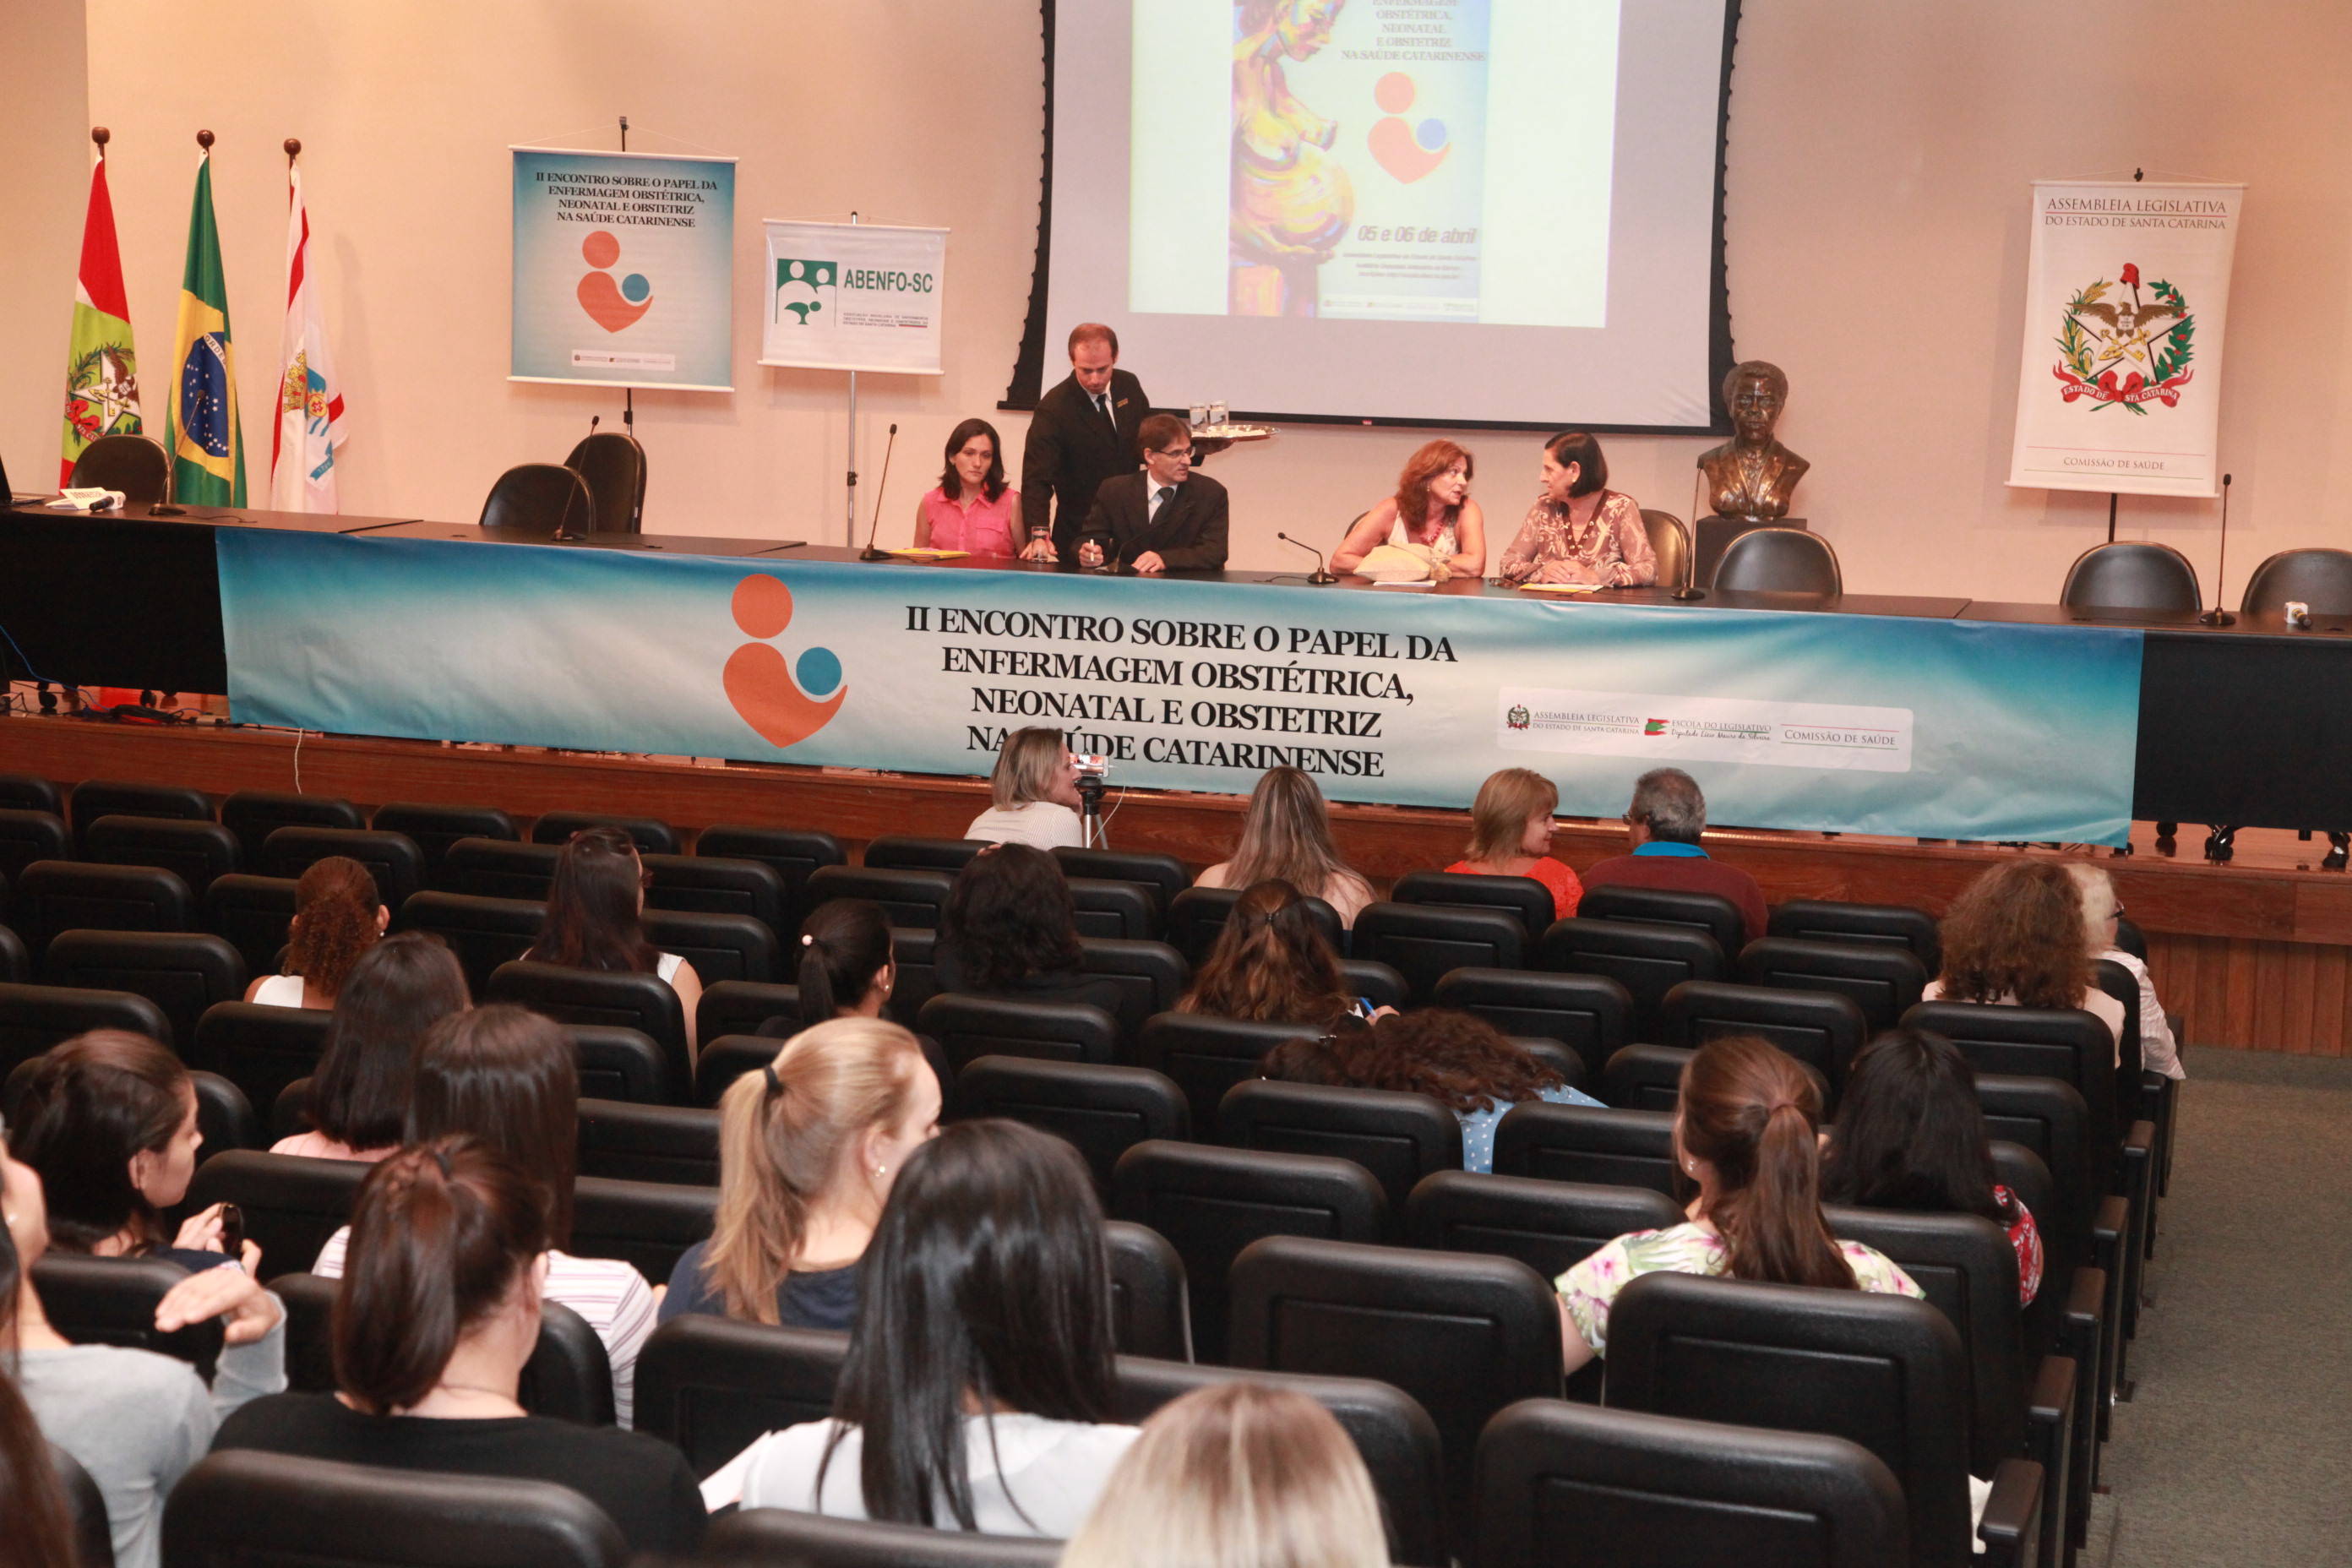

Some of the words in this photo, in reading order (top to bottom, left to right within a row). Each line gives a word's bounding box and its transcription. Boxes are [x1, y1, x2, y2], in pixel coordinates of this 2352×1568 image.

[1381, 24, 1446, 34] NEONATAL
[1376, 37, 1385, 46] E
[1386, 37, 1451, 47] OBSTETRIZ
[1341, 50, 1358, 59] NA
[1360, 47, 1401, 60] SAÚDE
[1402, 51, 1486, 62] CATARINENSE
[536, 172, 544, 182] II
[547, 172, 610, 185] ENCONTRO
[612, 176, 651, 187] SOBRE
[652, 178, 662, 188] O
[664, 179, 700, 189] PAPEL
[701, 181, 717, 190] DA
[548, 186, 629, 199] ENFERMAGEM
[632, 189, 705, 204] OBSTÉTRICA,
[558, 199, 621, 211] NEONATAL
[623, 203, 630, 211] E
[632, 203, 695, 215] OBSTETRIZ
[2047, 198, 2132, 211] ASSEMBLEIA
[2137, 199, 2227, 213] LEGISLATIVA
[558, 211, 574, 221] NA
[576, 211, 615, 224] SAÚDE
[617, 215, 696, 227] CATARINENSE
[2045, 216, 2063, 226] DO
[2066, 216, 2110, 227] ESTADO
[2112, 217, 2126, 227] DE
[2129, 218, 2166, 228] SANTA
[2168, 218, 2226, 229] CATARINA
[1357, 225, 1378, 242] 05
[1380, 229, 1391, 242] e
[1395, 226, 1416, 242] 06
[1418, 226, 1438, 243] de
[1441, 227, 1478, 244] abril
[844, 269, 933, 293] ABENFO-SC
[2063, 385, 2096, 395] ESTADO
[2142, 388, 2178, 400] CATARINA
[2063, 457, 2115, 468] COMISSÃO
[2117, 460, 2130, 469] DE
[2133, 460, 2164, 470] SAÚDE
[906, 606, 931, 632] II
[938, 607, 1124, 643] ENCONTRO
[1130, 618, 1246, 651] SOBRE
[1254, 625, 1280, 652] O
[1288, 628, 1399, 659] PAPEL
[1406, 635, 1459, 662] DA
[941, 646, 1184, 686] ENFERMAGEM
[1191, 661, 1414, 706] OBSTÉTRICA,
[972, 688, 1155, 723] NEONATAL
[1161, 700, 1184, 726] E
[1190, 701, 1382, 738] OBSTETRIZ
[1534, 711, 1585, 721] ASSEMBLEIA
[1587, 715, 1640, 724] LEGISLATIVA
[1605, 727, 1639, 735] CATARINA
[1671, 728, 1699, 739] Deputado
[1672, 720, 1701, 728] ESCOLA
[1704, 721, 1718, 730] DO
[1720, 723, 1772, 732] LEGISLATIVO
[1784, 729, 1841, 743] COMISSÃO
[1844, 734, 1859, 743] DE
[1861, 733, 1896, 745] SAÚDE
[1143, 737, 1385, 777] CATARINENSE
